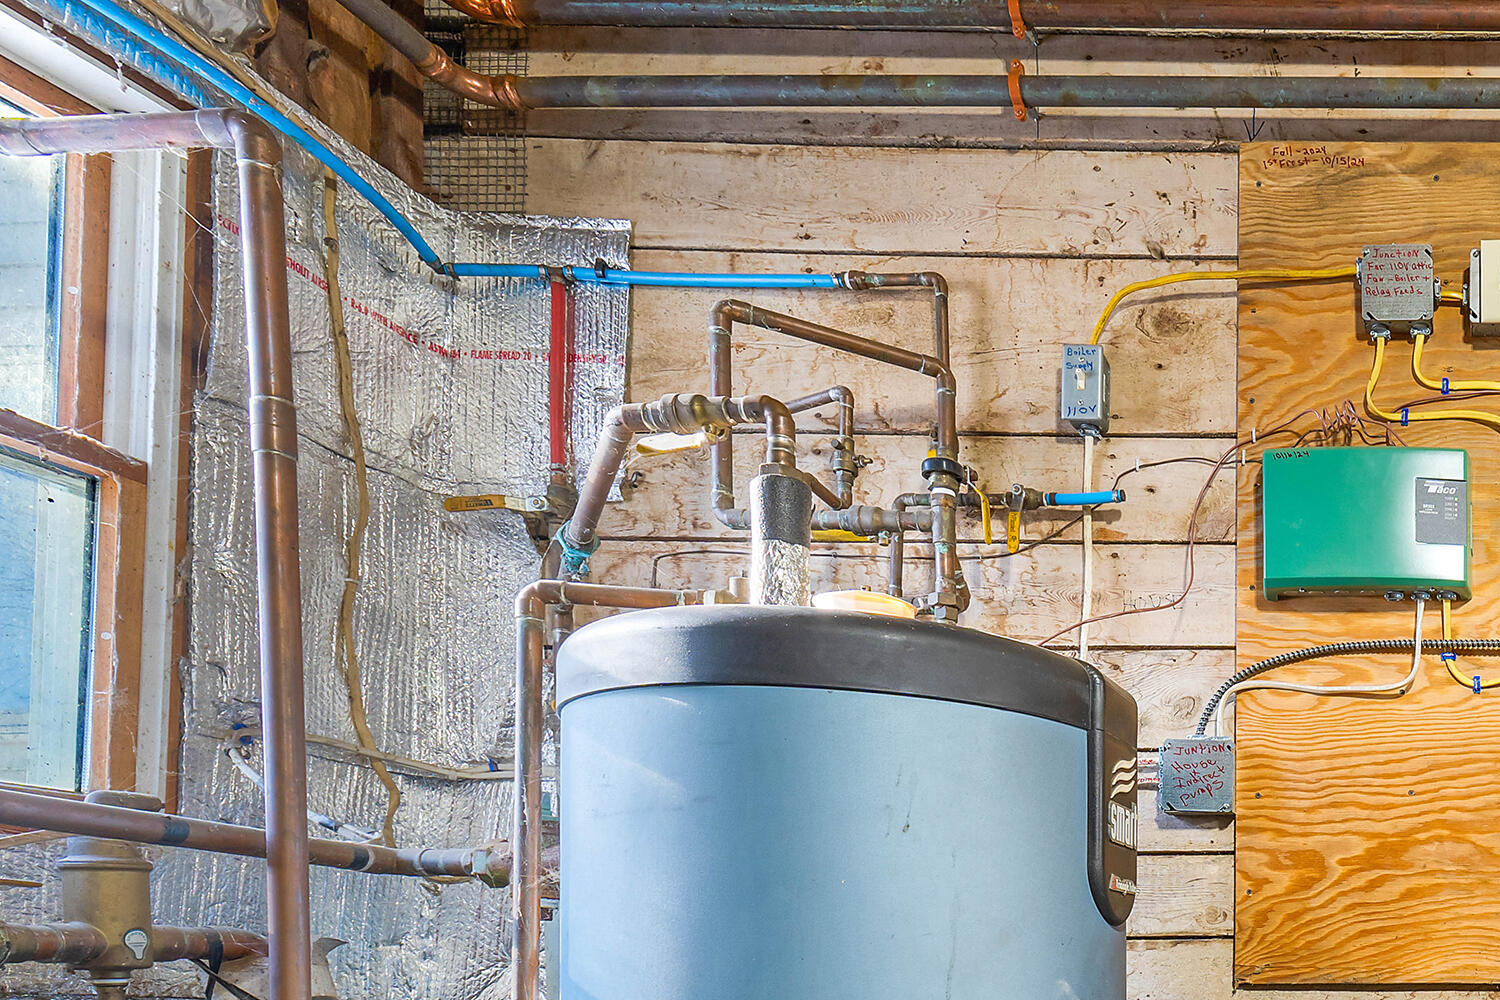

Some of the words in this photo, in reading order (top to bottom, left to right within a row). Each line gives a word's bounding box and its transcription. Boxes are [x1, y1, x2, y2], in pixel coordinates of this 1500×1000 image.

[1272, 145, 1293, 156] Fall
[1364, 286, 1392, 298] Relay
[286, 255, 310, 280] THOUT
[470, 349, 493, 360] FLAME
[494, 350, 521, 360] SPREAD
